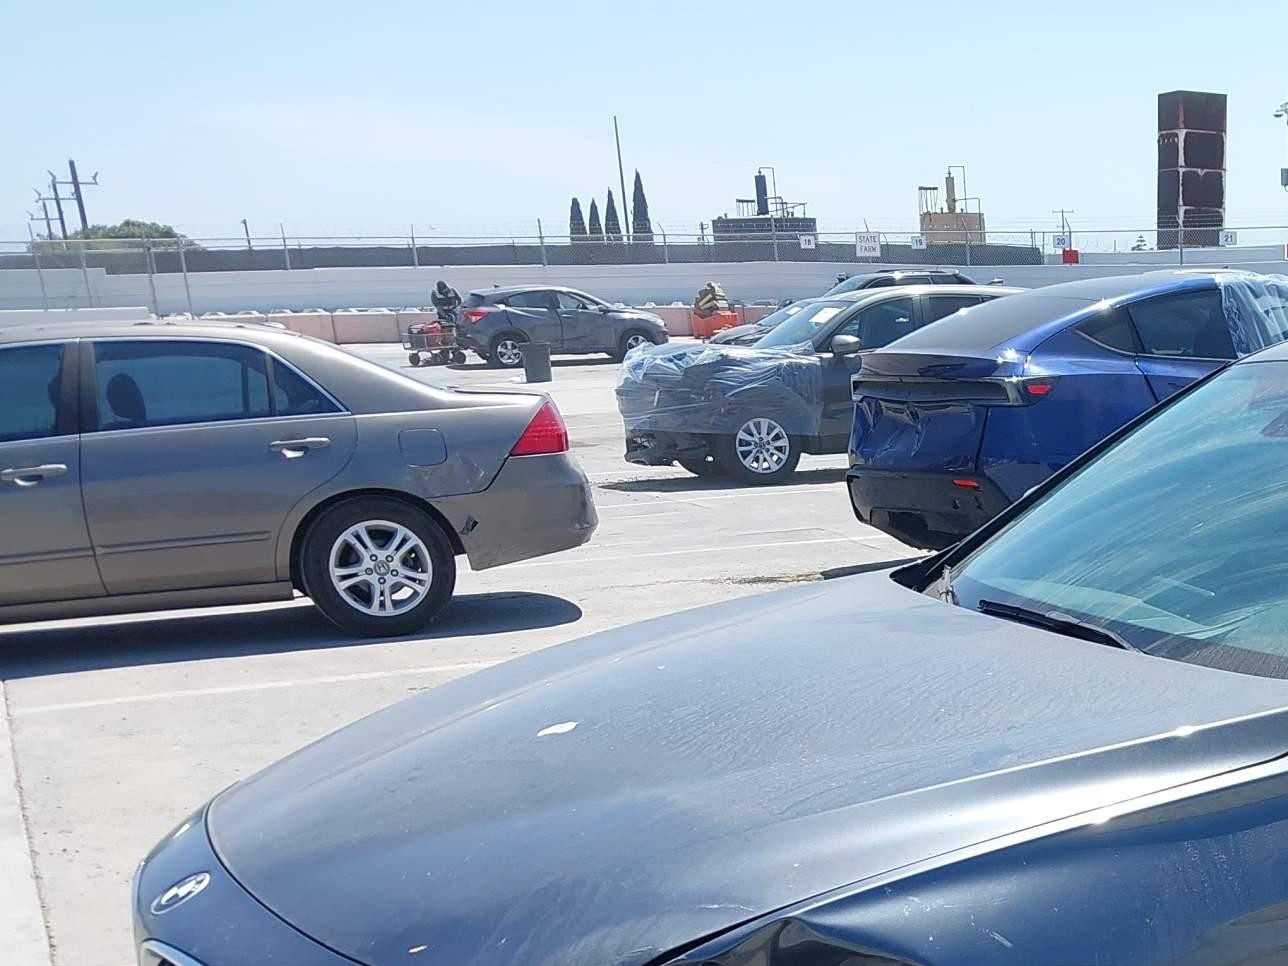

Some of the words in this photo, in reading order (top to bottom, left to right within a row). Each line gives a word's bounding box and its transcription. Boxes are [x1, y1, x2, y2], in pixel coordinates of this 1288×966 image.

[859, 235, 877, 243] STATE
[1056, 237, 1066, 245] 20
[1224, 234, 1233, 242] 21
